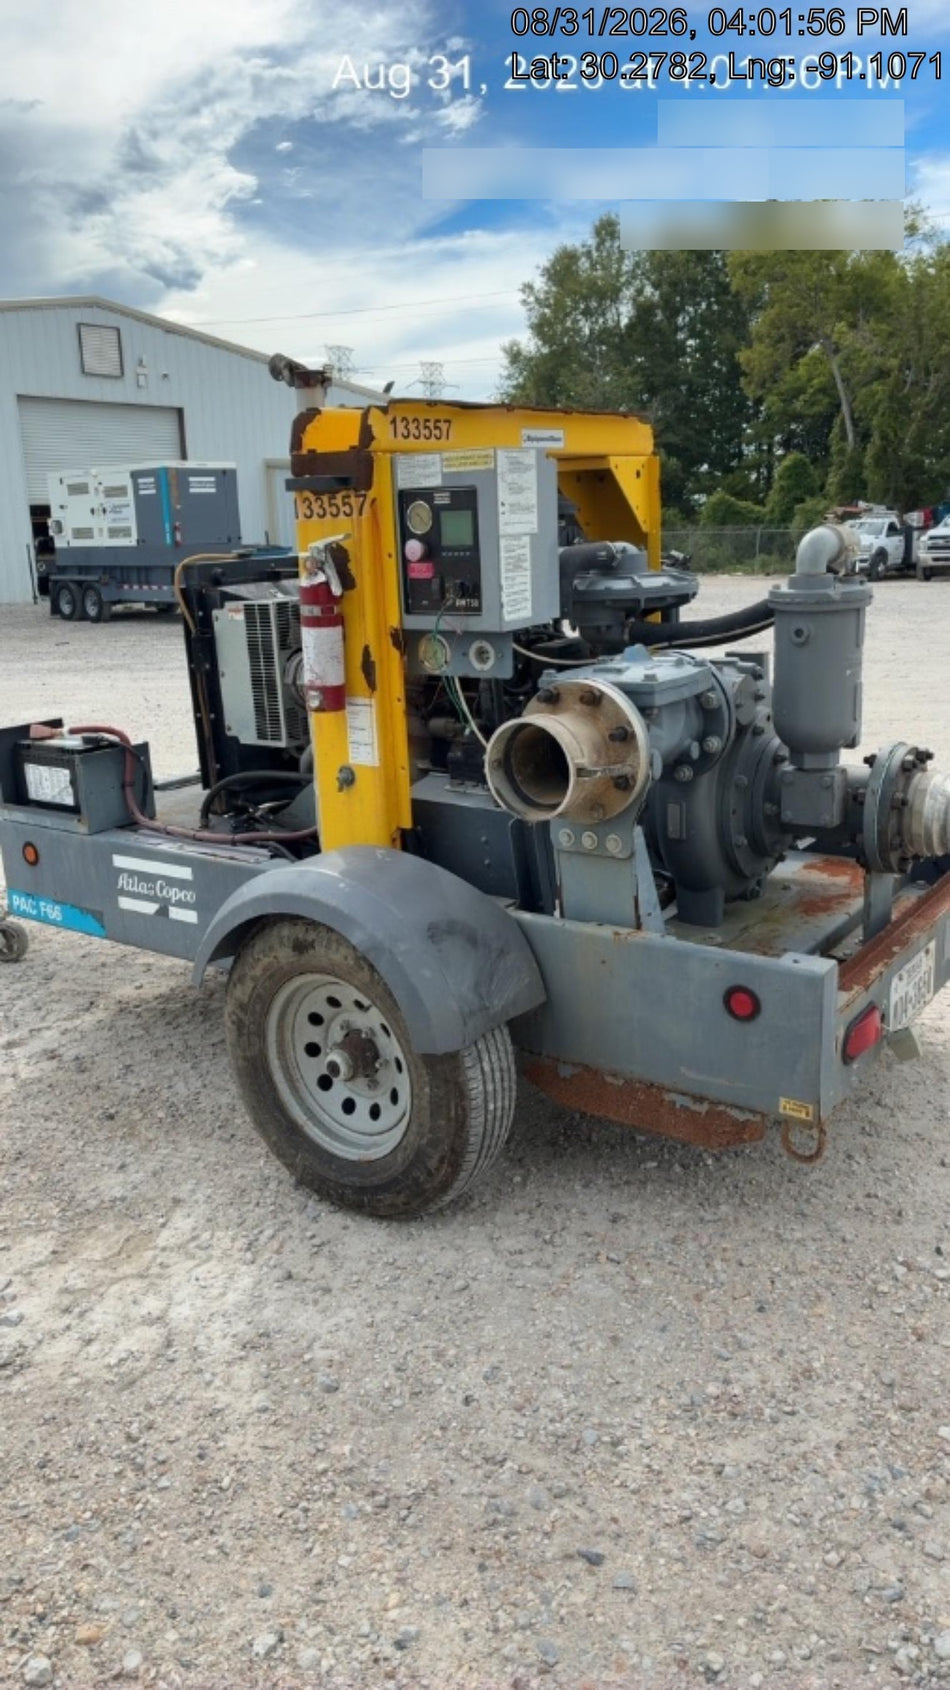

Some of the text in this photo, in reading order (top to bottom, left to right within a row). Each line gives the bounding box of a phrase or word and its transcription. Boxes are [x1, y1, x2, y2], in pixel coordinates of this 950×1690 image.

[390, 415, 452, 441] 133557
[117, 872, 196, 905] Atlas Copco
[12, 894, 64, 922] PAC F66
